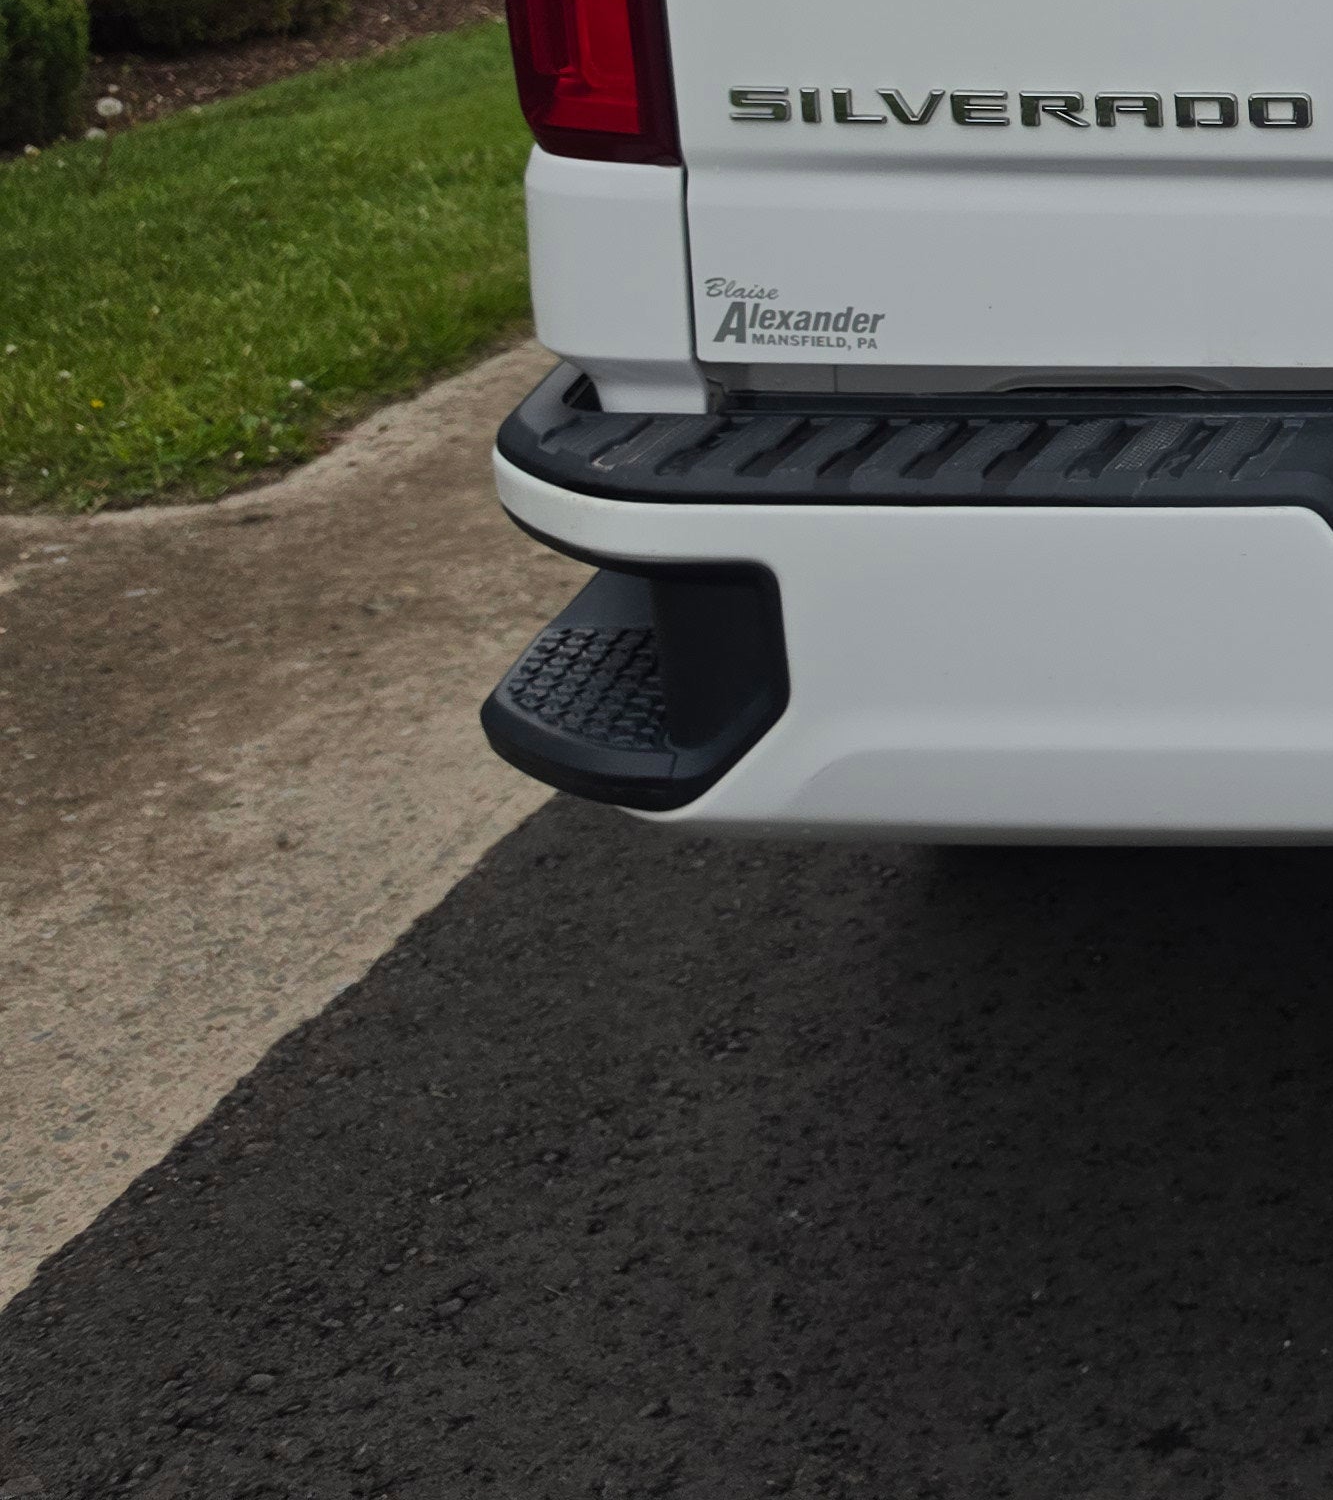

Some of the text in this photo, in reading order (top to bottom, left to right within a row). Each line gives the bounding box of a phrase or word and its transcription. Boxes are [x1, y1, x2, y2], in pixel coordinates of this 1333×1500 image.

[728, 86, 1314, 129] SILVERADO
[704, 277, 780, 300] Blaise
[713, 301, 886, 344] Alexander
[751, 333, 878, 351] MANSFIELD, PA
